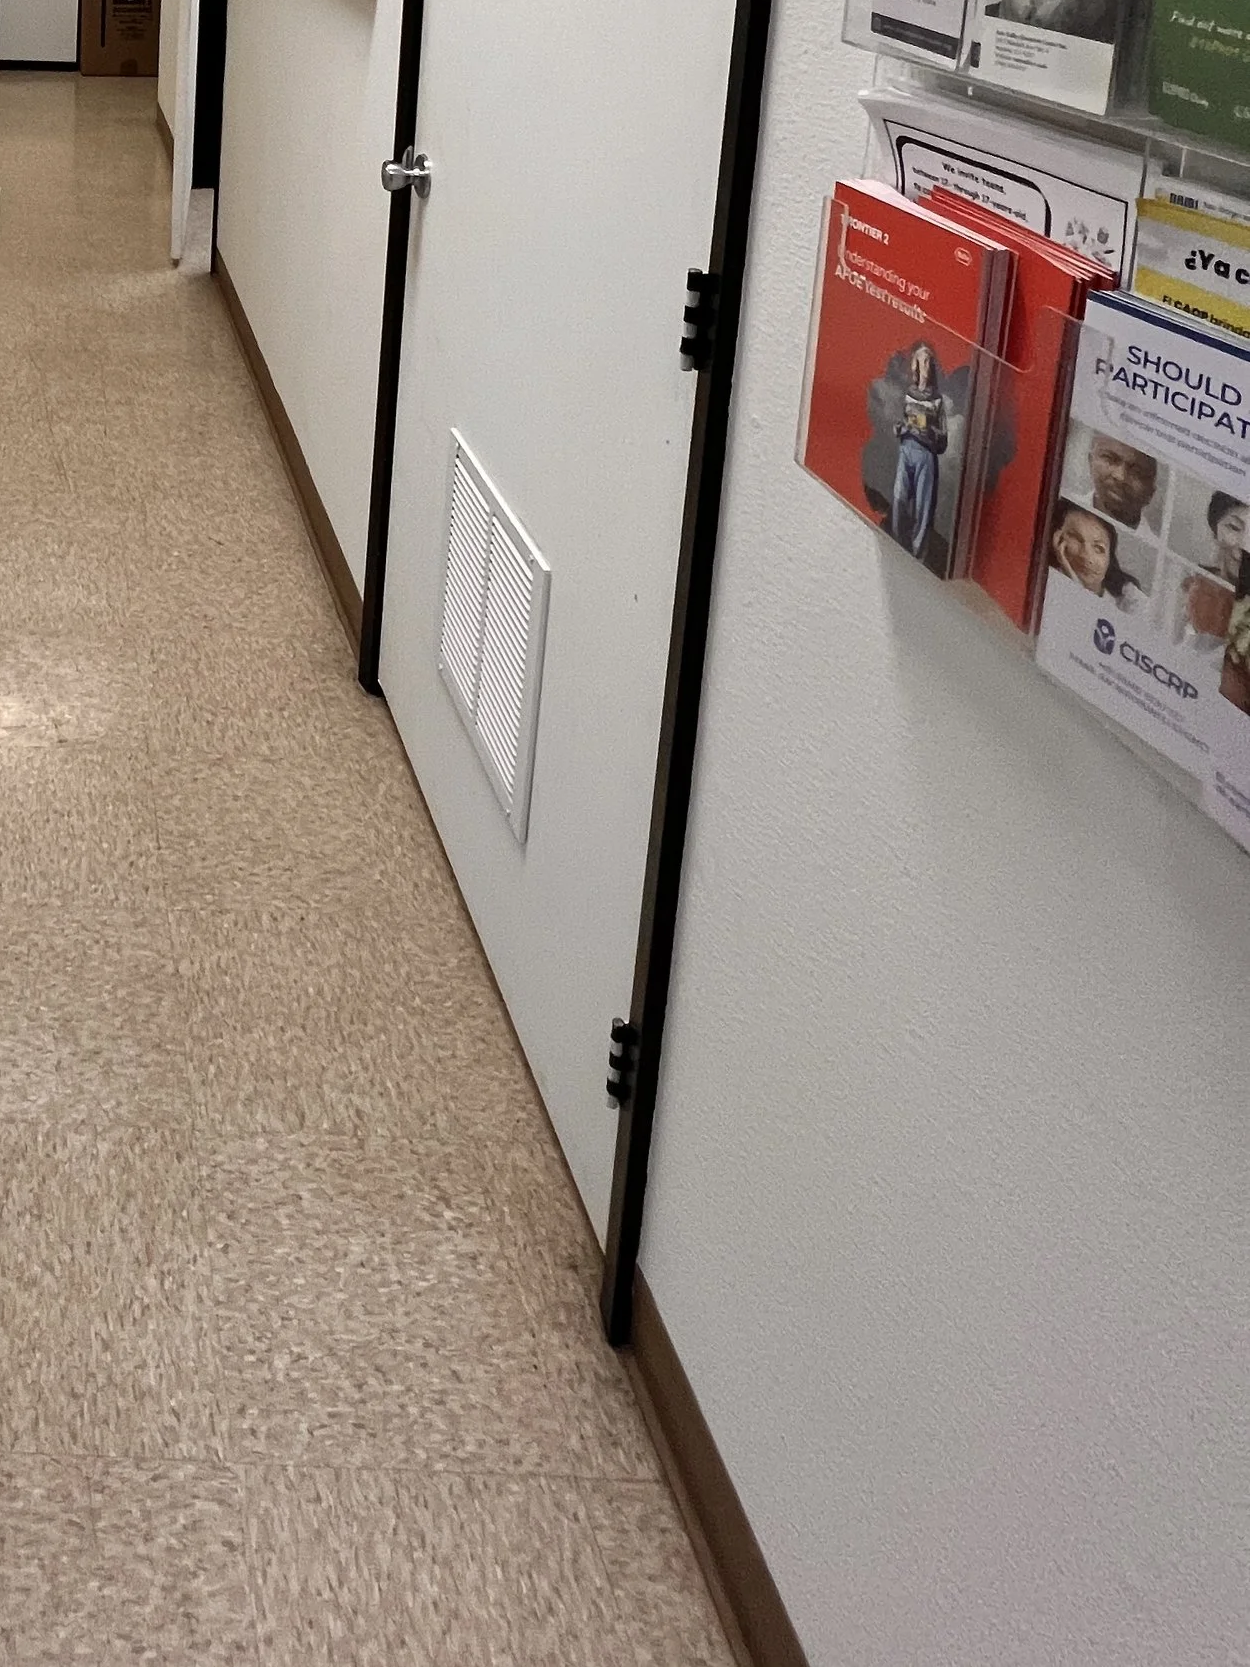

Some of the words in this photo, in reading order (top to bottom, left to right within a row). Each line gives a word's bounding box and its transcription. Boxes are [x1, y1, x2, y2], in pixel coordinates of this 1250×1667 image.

[883, 233, 890, 246] 2
[1184, 249, 1231, 279] ¿Ya
[907, 279, 931, 301] your
[1127, 345, 1242, 406] SHOULD
[1095, 358, 1250, 439] PARTICIPAT
[1119, 641, 1199, 699] CISCRP
